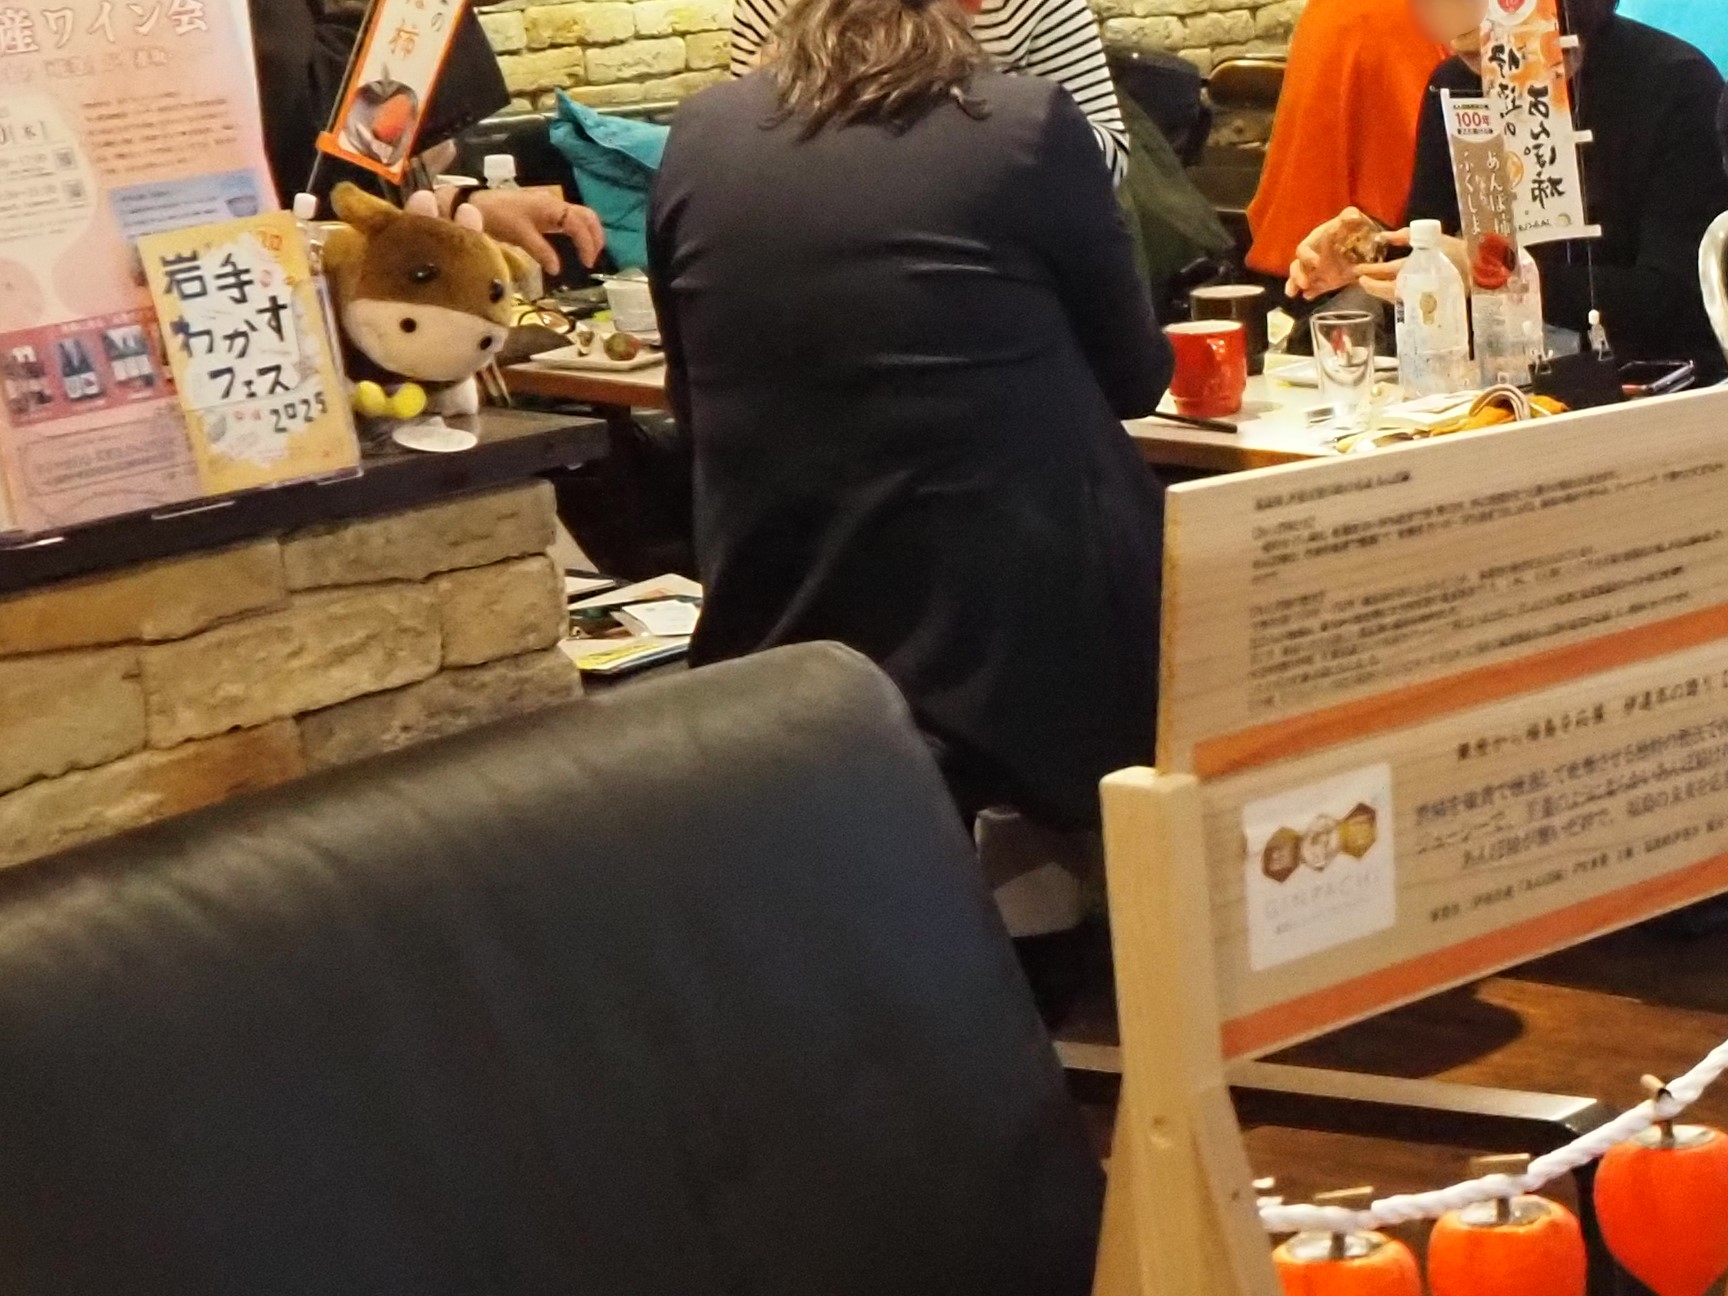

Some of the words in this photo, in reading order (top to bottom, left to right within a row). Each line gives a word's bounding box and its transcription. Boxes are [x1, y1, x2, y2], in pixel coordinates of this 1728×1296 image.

[161, 250, 255, 305] 岩手
[174, 294, 289, 360] わかす
[207, 363, 294, 402] フェス
[269, 390, 329, 435] 2025
